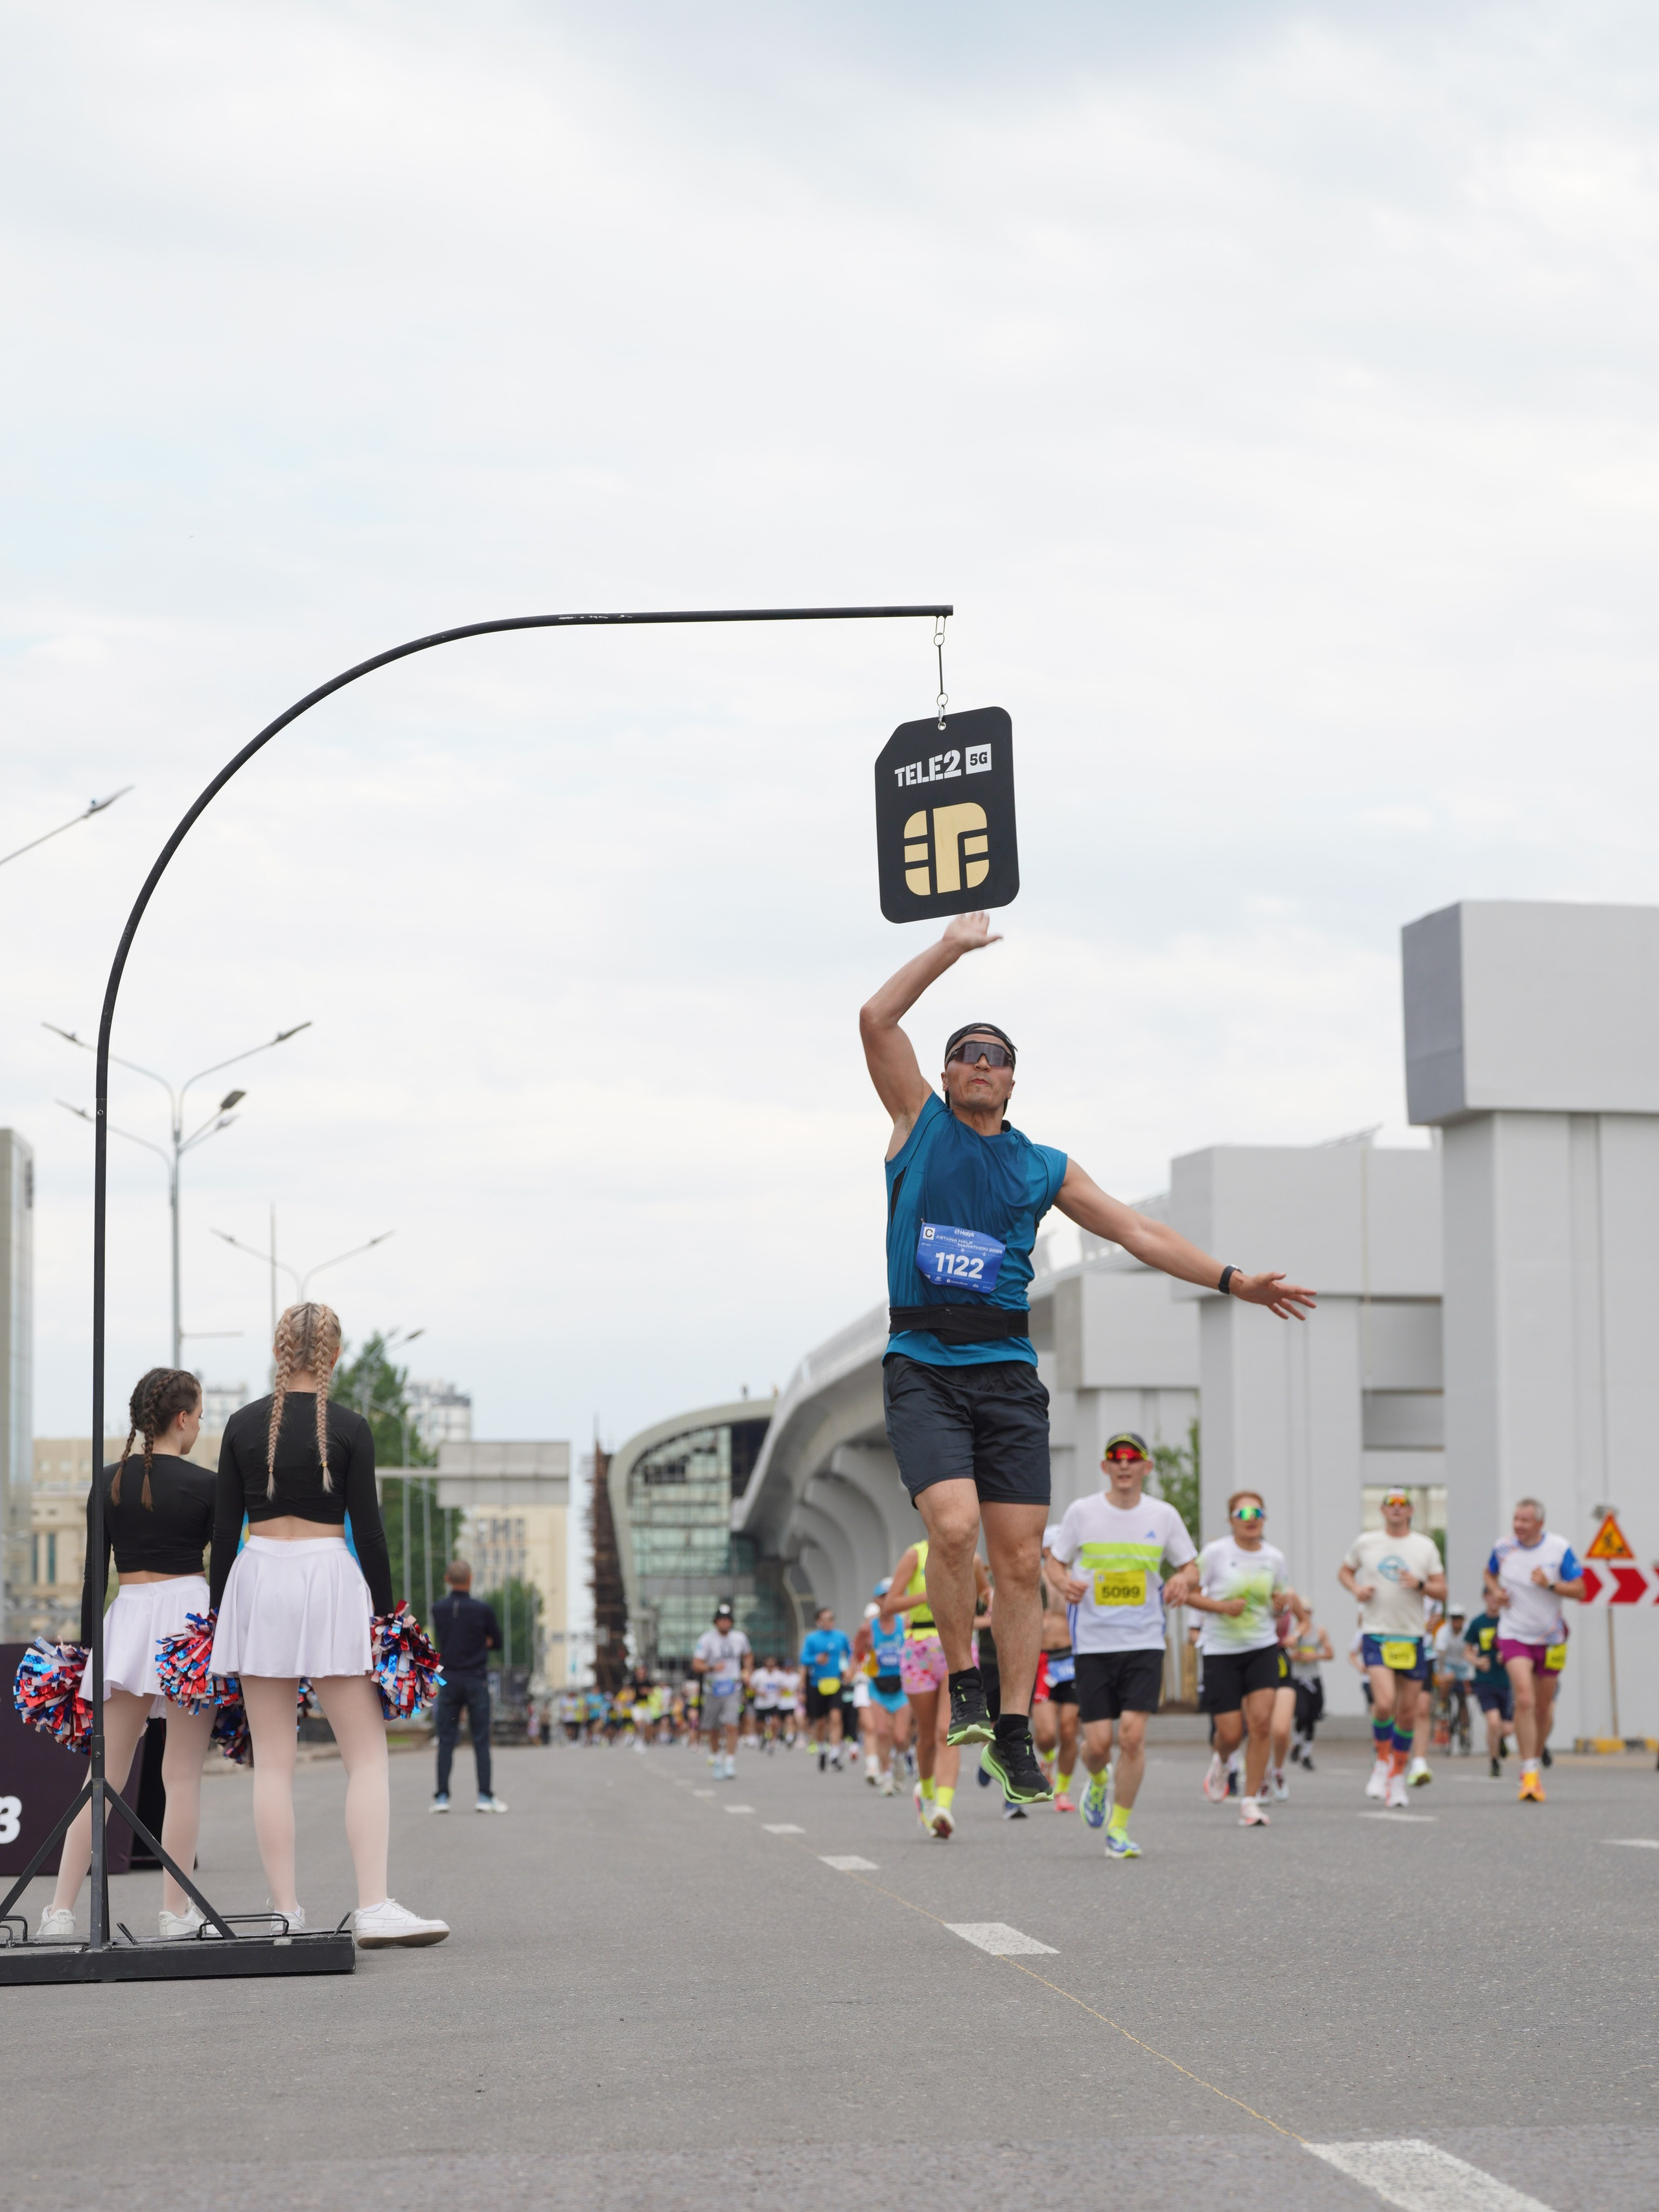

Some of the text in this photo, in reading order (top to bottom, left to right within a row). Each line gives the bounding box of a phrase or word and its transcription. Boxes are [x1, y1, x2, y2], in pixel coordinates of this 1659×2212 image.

[894, 750, 988, 787] TELE2 5G
[925, 1228, 933, 1238] C
[958, 1243, 988, 1252] MARATHON
[935, 1252, 984, 1279] 1122
[1102, 1585, 1141, 1599] 5099
